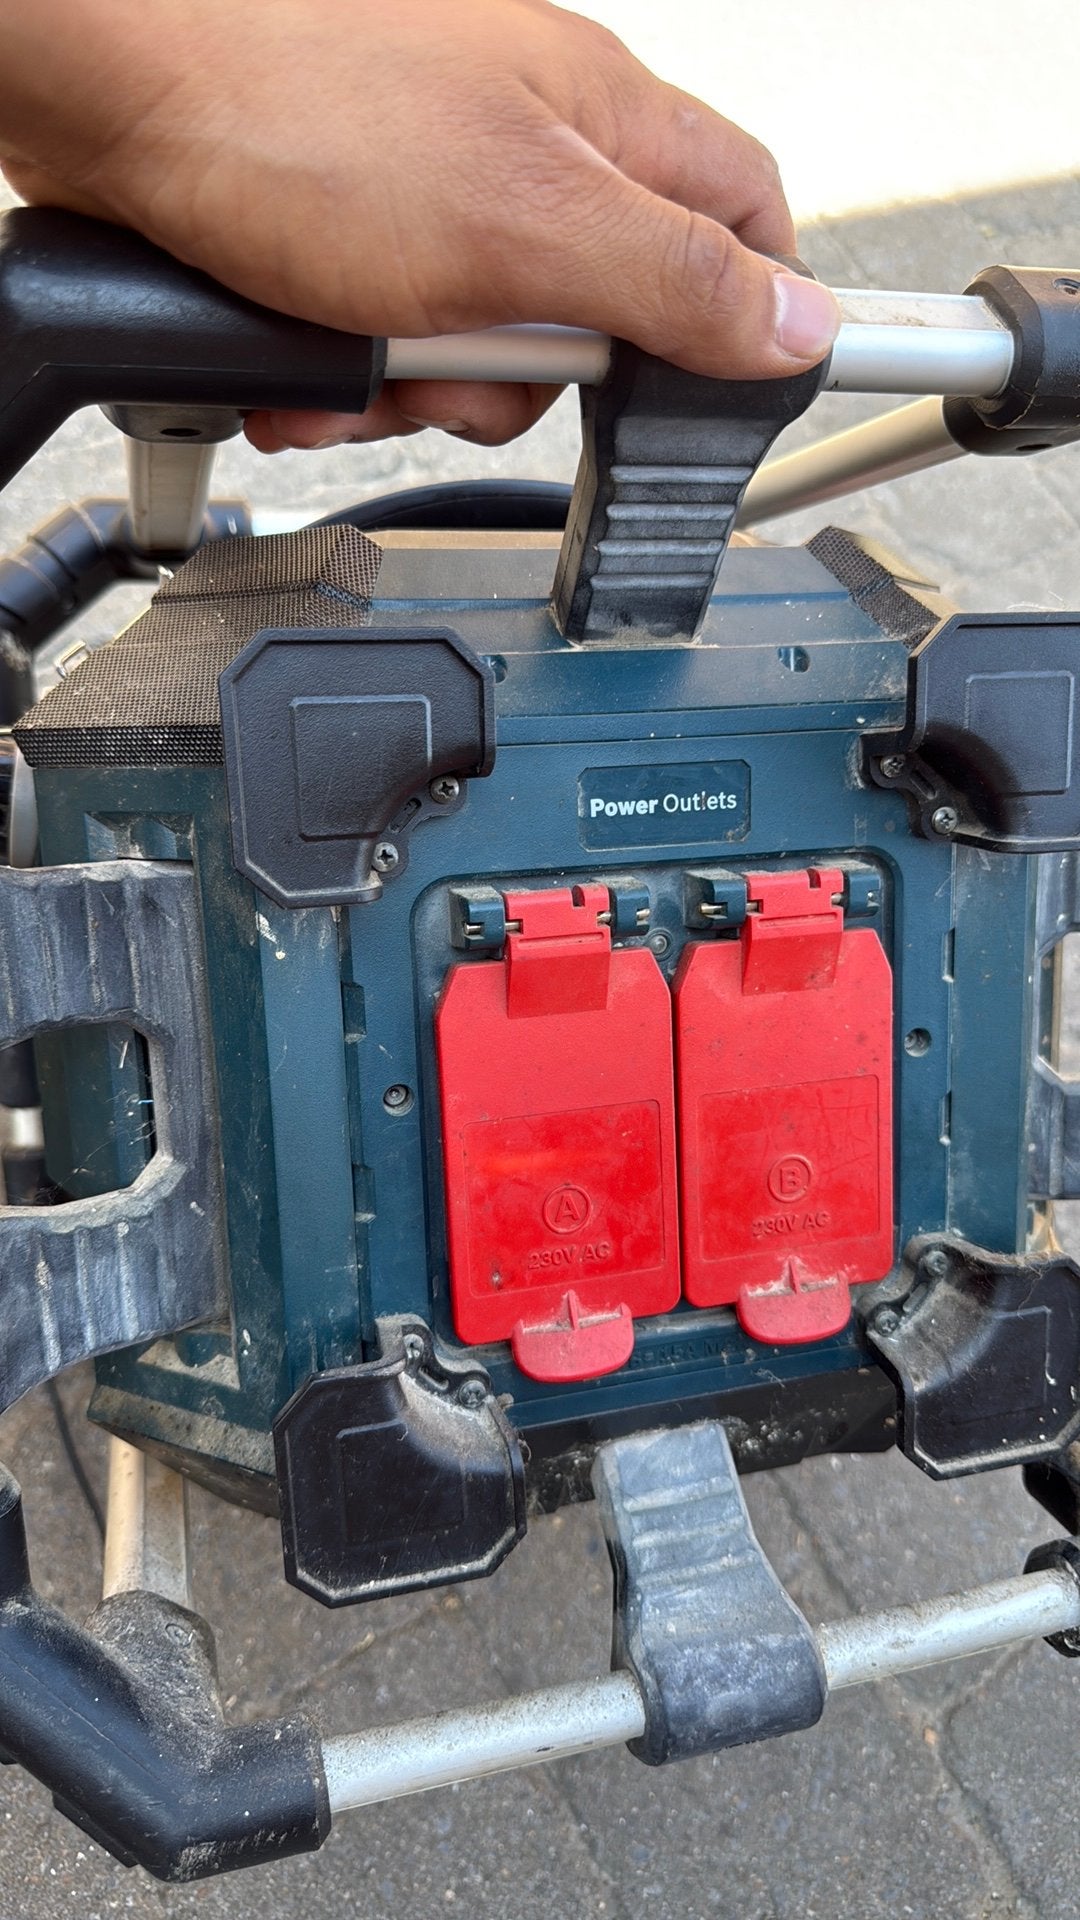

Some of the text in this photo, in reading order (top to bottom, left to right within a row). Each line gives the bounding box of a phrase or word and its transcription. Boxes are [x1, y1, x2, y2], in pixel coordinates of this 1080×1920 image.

[590, 791, 738, 818] Power Outlets
[527, 1245, 577, 1270] 230V
